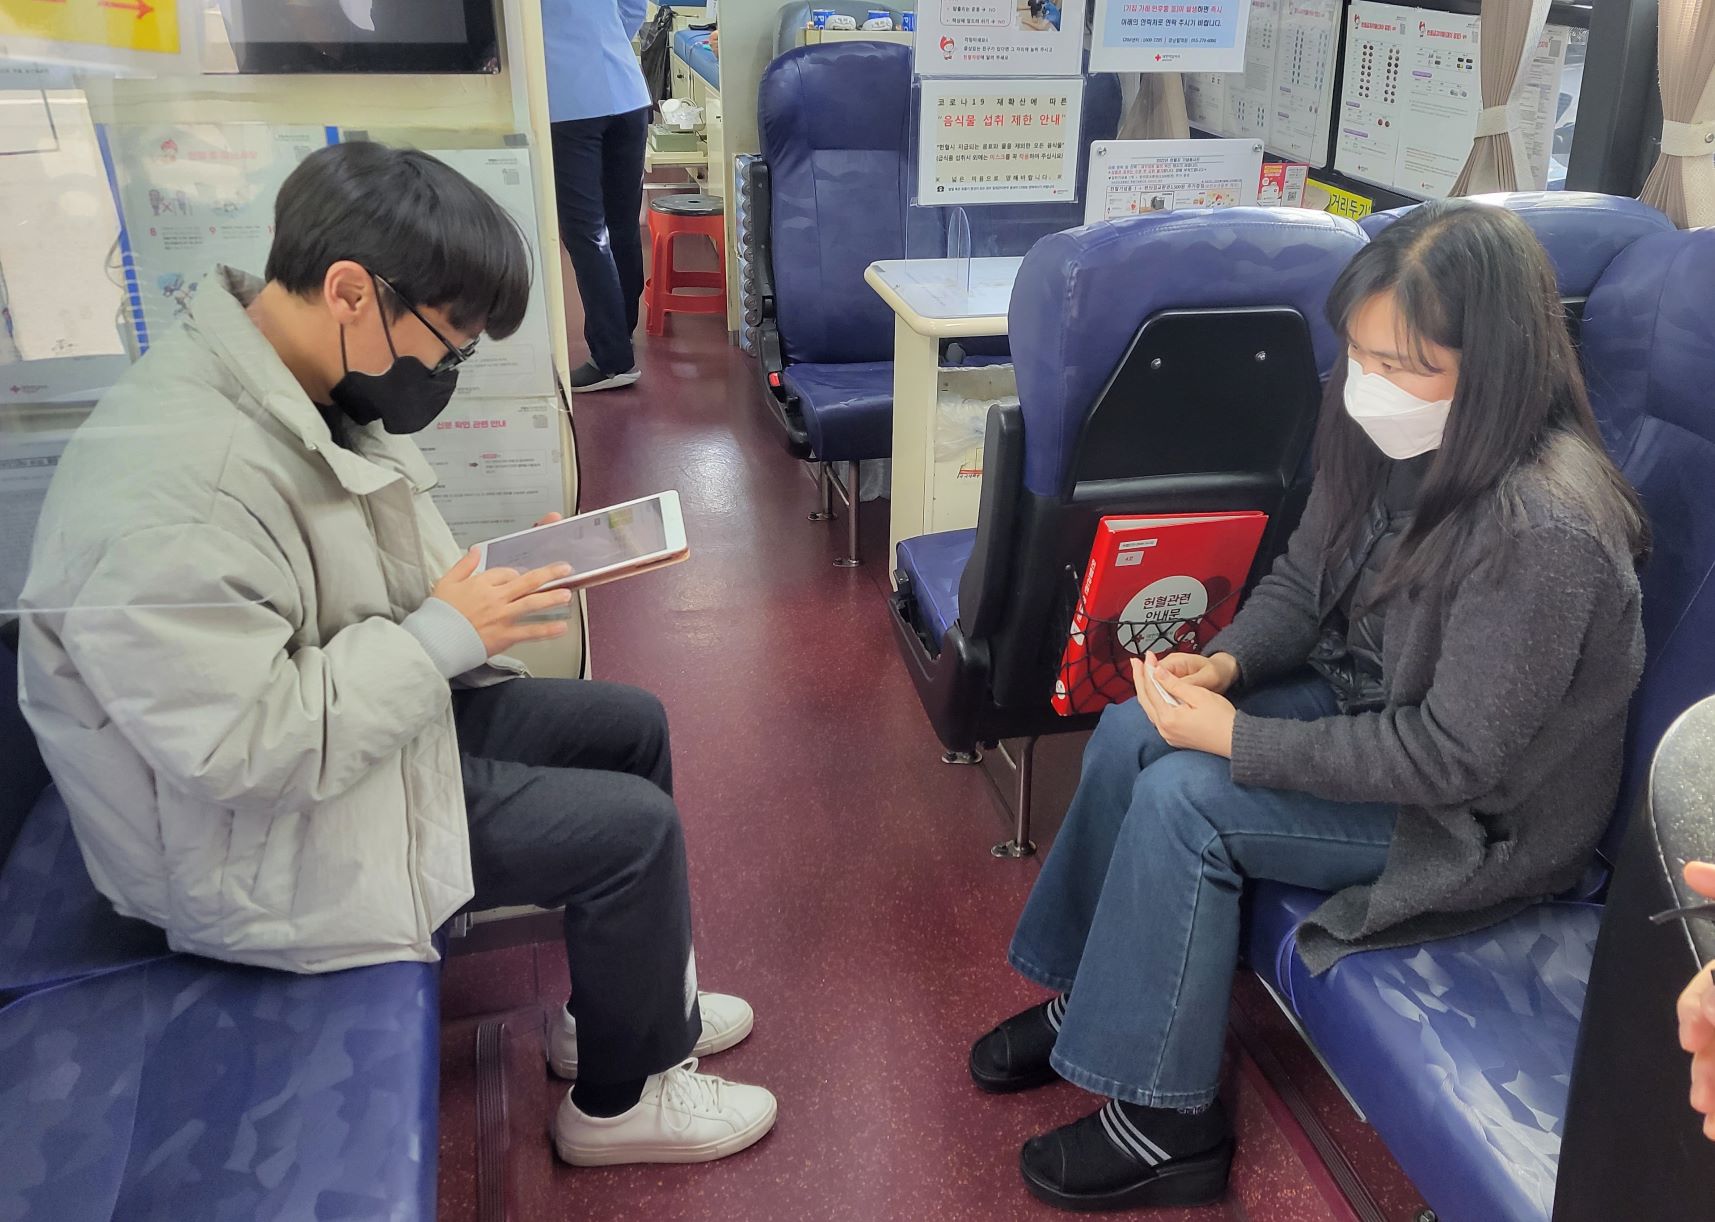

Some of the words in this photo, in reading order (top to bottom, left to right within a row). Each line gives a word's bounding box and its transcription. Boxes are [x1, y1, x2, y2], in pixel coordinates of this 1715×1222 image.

[938, 98, 985, 106] 코로나19
[997, 98, 1038, 106] 재확산에
[1049, 98, 1067, 106] 따른
[984, 114, 1004, 127] 섭취
[1011, 114, 1033, 126] 제한
[491, 420, 507, 428] 안내
[1143, 593, 1191, 610] 헌혈관련
[1145, 609, 1180, 622] 안내문
